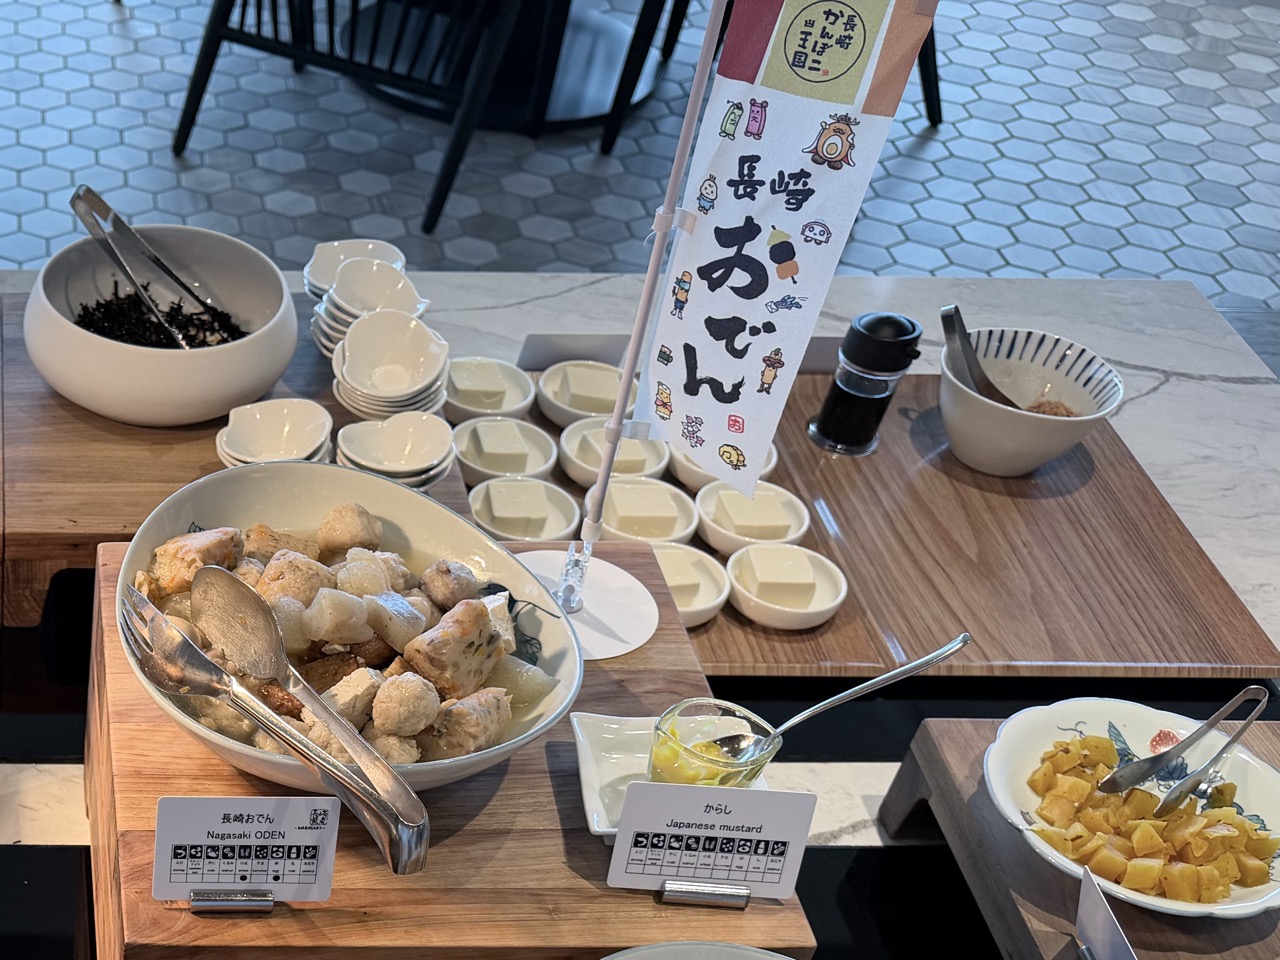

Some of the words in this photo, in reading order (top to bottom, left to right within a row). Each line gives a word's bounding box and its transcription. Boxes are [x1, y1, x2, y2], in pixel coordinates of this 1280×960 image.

[835, 15, 858, 50] 長崎
[792, 30, 812, 69] 王国
[727, 154, 815, 212] 長崎
[684, 216, 778, 404] おでん
[221, 813, 275, 824] 長崎おでん
[704, 802, 731, 815] からし
[207, 830, 250, 840] Nagasaki
[254, 830, 285, 839] ODEN
[666, 819, 715, 830] Japanese
[719, 824, 762, 833] mustard
